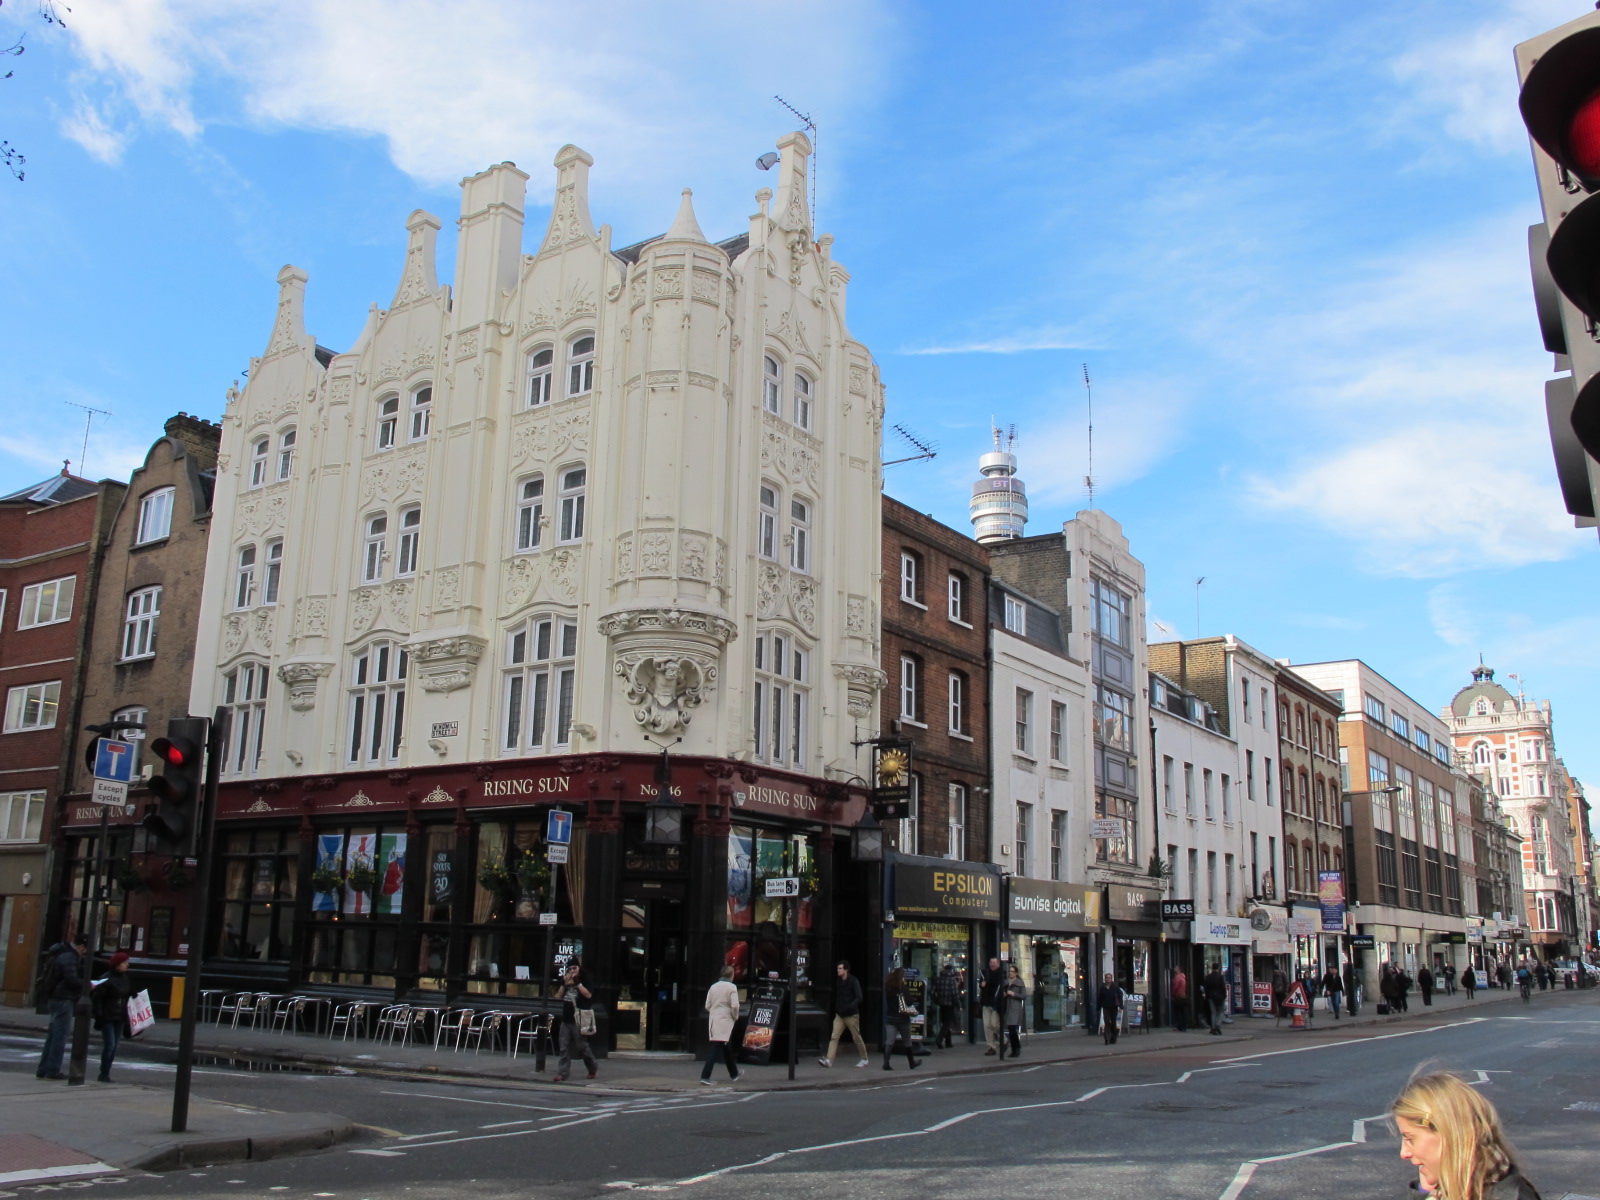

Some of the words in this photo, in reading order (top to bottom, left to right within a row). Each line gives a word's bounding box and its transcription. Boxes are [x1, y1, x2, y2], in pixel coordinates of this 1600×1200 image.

[992, 480, 1009, 488] BT
[98, 783, 123, 793] Except
[483, 778, 533, 796] RISING
[538, 776, 570, 793] SUN
[97, 794, 121, 803] cycles
[748, 785, 790, 807] RISING
[793, 793, 817, 811] SUN
[76, 806, 103, 820] RISING
[108, 804, 124, 818] UN
[550, 847, 567, 855] Except
[434, 877, 449, 893] 3D
[933, 871, 992, 895] EPSILON
[942, 894, 989, 907] Computers
[1014, 895, 1051, 912] sunrise
[1053, 897, 1082, 918] digital
[1209, 922, 1227, 938] Laptop
[558, 945, 574, 955] LIVE
[131, 1005, 153, 1027] SALE
